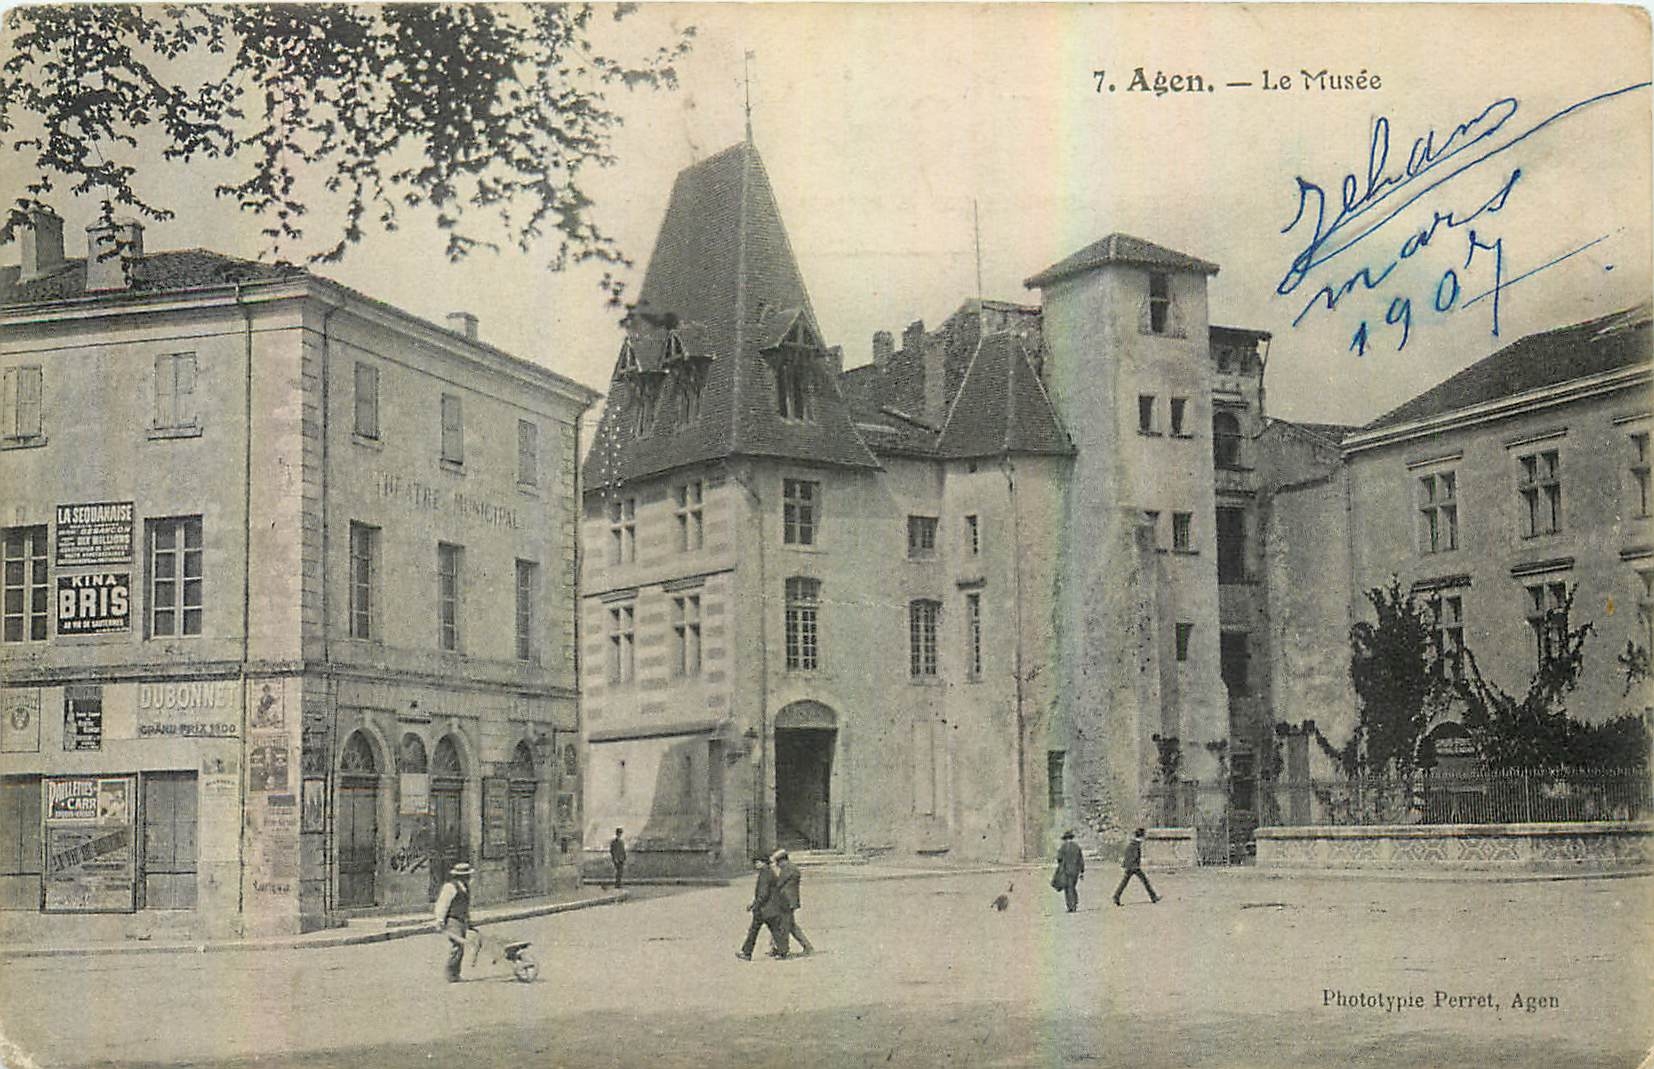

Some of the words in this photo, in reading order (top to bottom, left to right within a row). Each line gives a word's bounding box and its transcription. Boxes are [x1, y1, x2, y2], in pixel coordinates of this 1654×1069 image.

[58, 507, 71, 524] LA
[453, 492, 520, 530] MUNICIPAL
[72, 574, 117, 587] KINA
[59, 586, 129, 619] BRIS
[141, 682, 236, 709] DUBONNET
